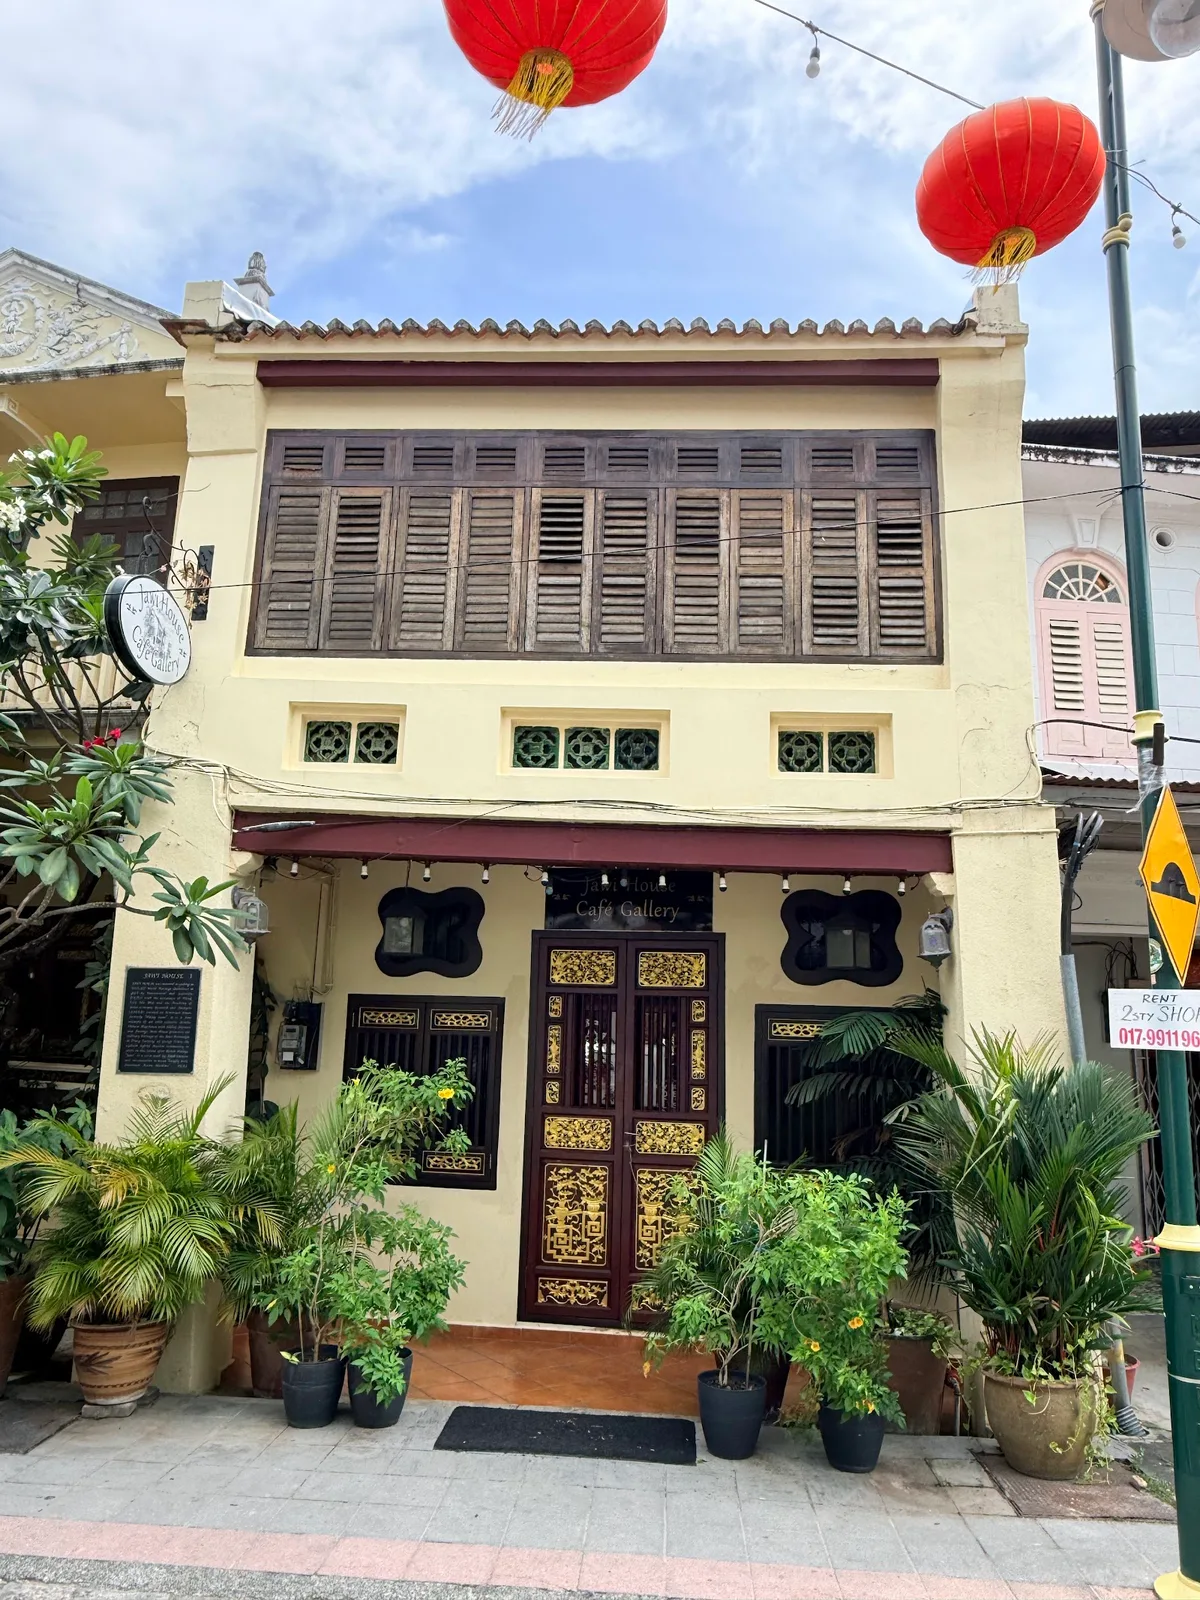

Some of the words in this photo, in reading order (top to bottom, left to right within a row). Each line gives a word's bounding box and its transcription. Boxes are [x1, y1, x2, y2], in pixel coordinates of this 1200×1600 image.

[139, 584, 160, 612] Jawi
[160, 592, 184, 644] House
[151, 649, 180, 677] Gallery
[580, 876, 618, 897] Jawi
[576, 898, 613, 922] Café
[621, 899, 680, 923] Gallery
[1142, 993, 1178, 1004] RENT
